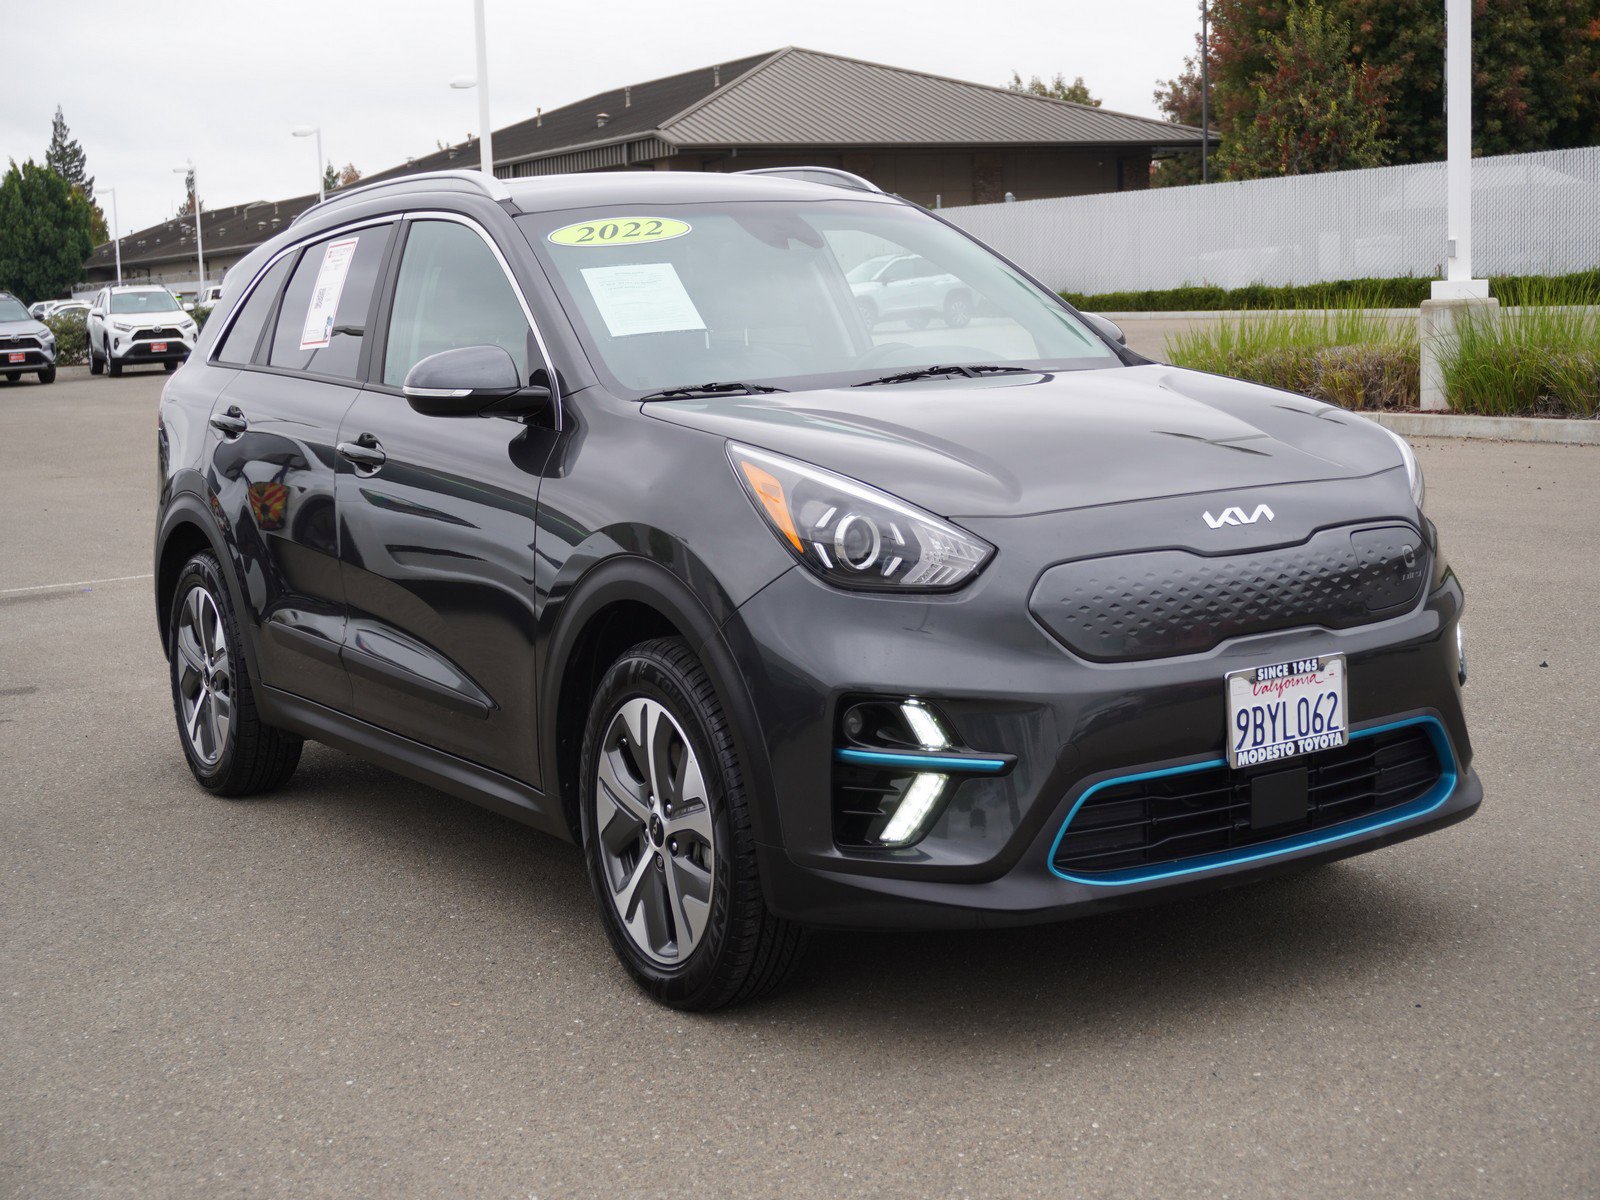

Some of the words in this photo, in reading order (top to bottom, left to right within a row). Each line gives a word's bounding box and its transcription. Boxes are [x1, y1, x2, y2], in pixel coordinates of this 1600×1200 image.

[576, 221, 663, 242] 2022
[1202, 504, 1274, 529] KIA
[1258, 665, 1289, 681] SINCE
[1293, 659, 1318, 674] 1965
[1253, 673, 1324, 698] California
[1236, 691, 1340, 751] 9BYL062
[1237, 744, 1295, 766] MODESTO
[1298, 733, 1343, 753] TOYOTA
